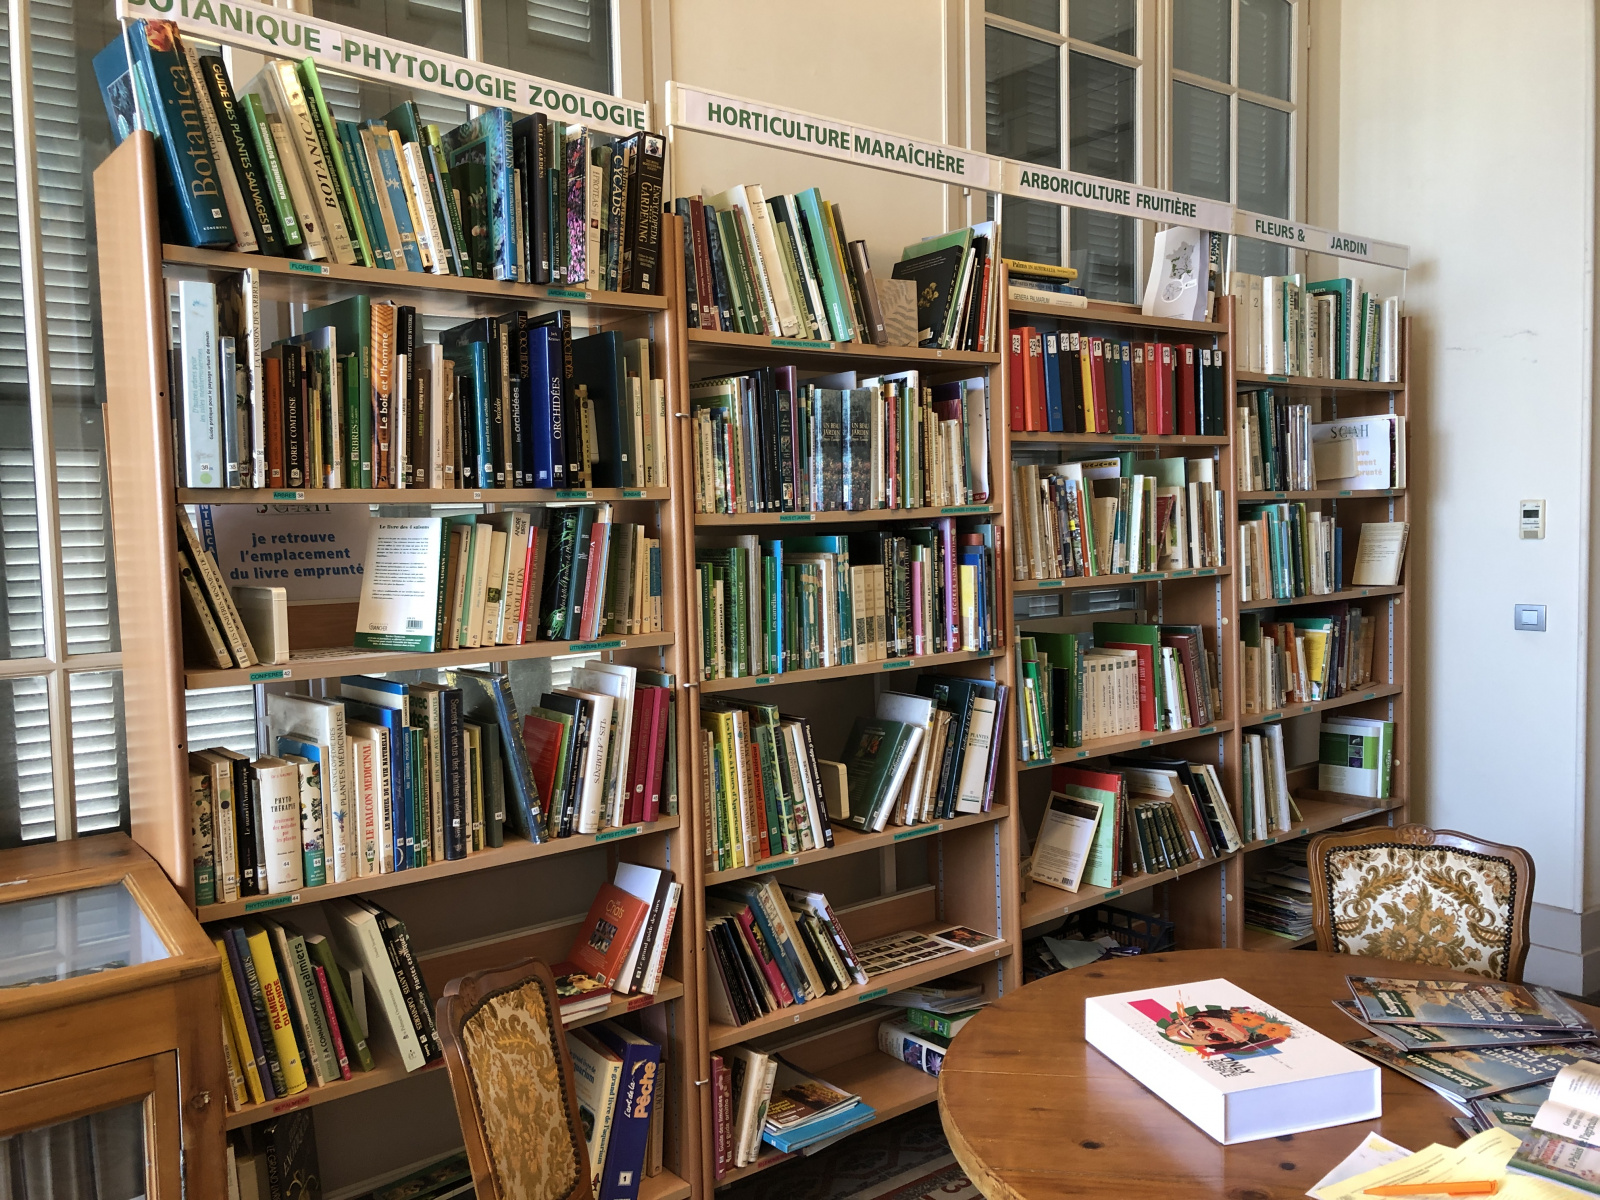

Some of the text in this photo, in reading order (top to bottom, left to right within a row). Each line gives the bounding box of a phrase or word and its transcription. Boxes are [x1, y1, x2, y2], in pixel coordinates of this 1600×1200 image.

[127, 0, 321, 53] OTANIQUE
[528, 84, 645, 131] ZOOLOGIE
[306, 95, 320, 122] Plantes
[170, 65, 219, 199] Botanica
[210, 62, 270, 224] GUIDE DES PLANTES SAUVAGES
[504, 120, 513, 168] SUCCULENTS
[708, 102, 965, 175] HORTICULTURE MARAÎCHÈRE
[295, 111, 337, 210] BOTANICA
[591, 174, 600, 207] PROTEAS
[611, 155, 622, 215] CYCADS
[1020, 170, 1197, 218] ARBORICULTURE FRUITIÈRE
[638, 181, 653, 243] GARDENING
[647, 184, 660, 247] ENCYCLOPEDIA
[1255, 219, 1368, 256] FLEURS & JARDIN
[1012, 261, 1027, 269] Palms
[251, 280, 259, 309] ARBRES
[254, 358, 261, 367] LA
[379, 333, 389, 428] Le bois et l'homme
[511, 387, 520, 431] orchidées
[550, 377, 562, 439] ORCHIDÉES
[288, 396, 298, 464] FORET COMTOISE
[350, 424, 359, 455] RBRES
[240, 547, 351, 564] l'emplacement
[252, 533, 336, 547] je retrouve
[230, 562, 364, 581] du livre emprunté
[507, 570, 515, 598] AUTRE
[449, 698, 459, 724] Secrets
[335, 711, 347, 805] PLANTES MÉDICINALES
[450, 735, 459, 756] vertus
[451, 758, 459, 770] des
[592, 718, 606, 783] LES ALIMENTS
[329, 741, 338, 792] ENCYCLOPÉDIE
[382, 778, 389, 786] LA
[450, 772, 460, 796] plantes
[362, 743, 374, 839] LE BALCON MEDICINAL
[384, 822, 390, 830] LE
[292, 942, 328, 1047] CONNAISSANCE DES palmiers
[408, 965, 422, 989] Plantes
[265, 982, 282, 1031] PALMIERS
[275, 979, 291, 1027] DU MONDE
[395, 969, 422, 1031] PLANTES CARNIVORES
[607, 1073, 617, 1095] grand
[1221, 1057, 1255, 1074] ONLY
[605, 1096, 614, 1114] livre
[621, 1080, 636, 1117] L'art de la
[634, 1060, 657, 1119] Pêche
[603, 1115, 610, 1123] de
[596, 1124, 609, 1164] l'aquarium
